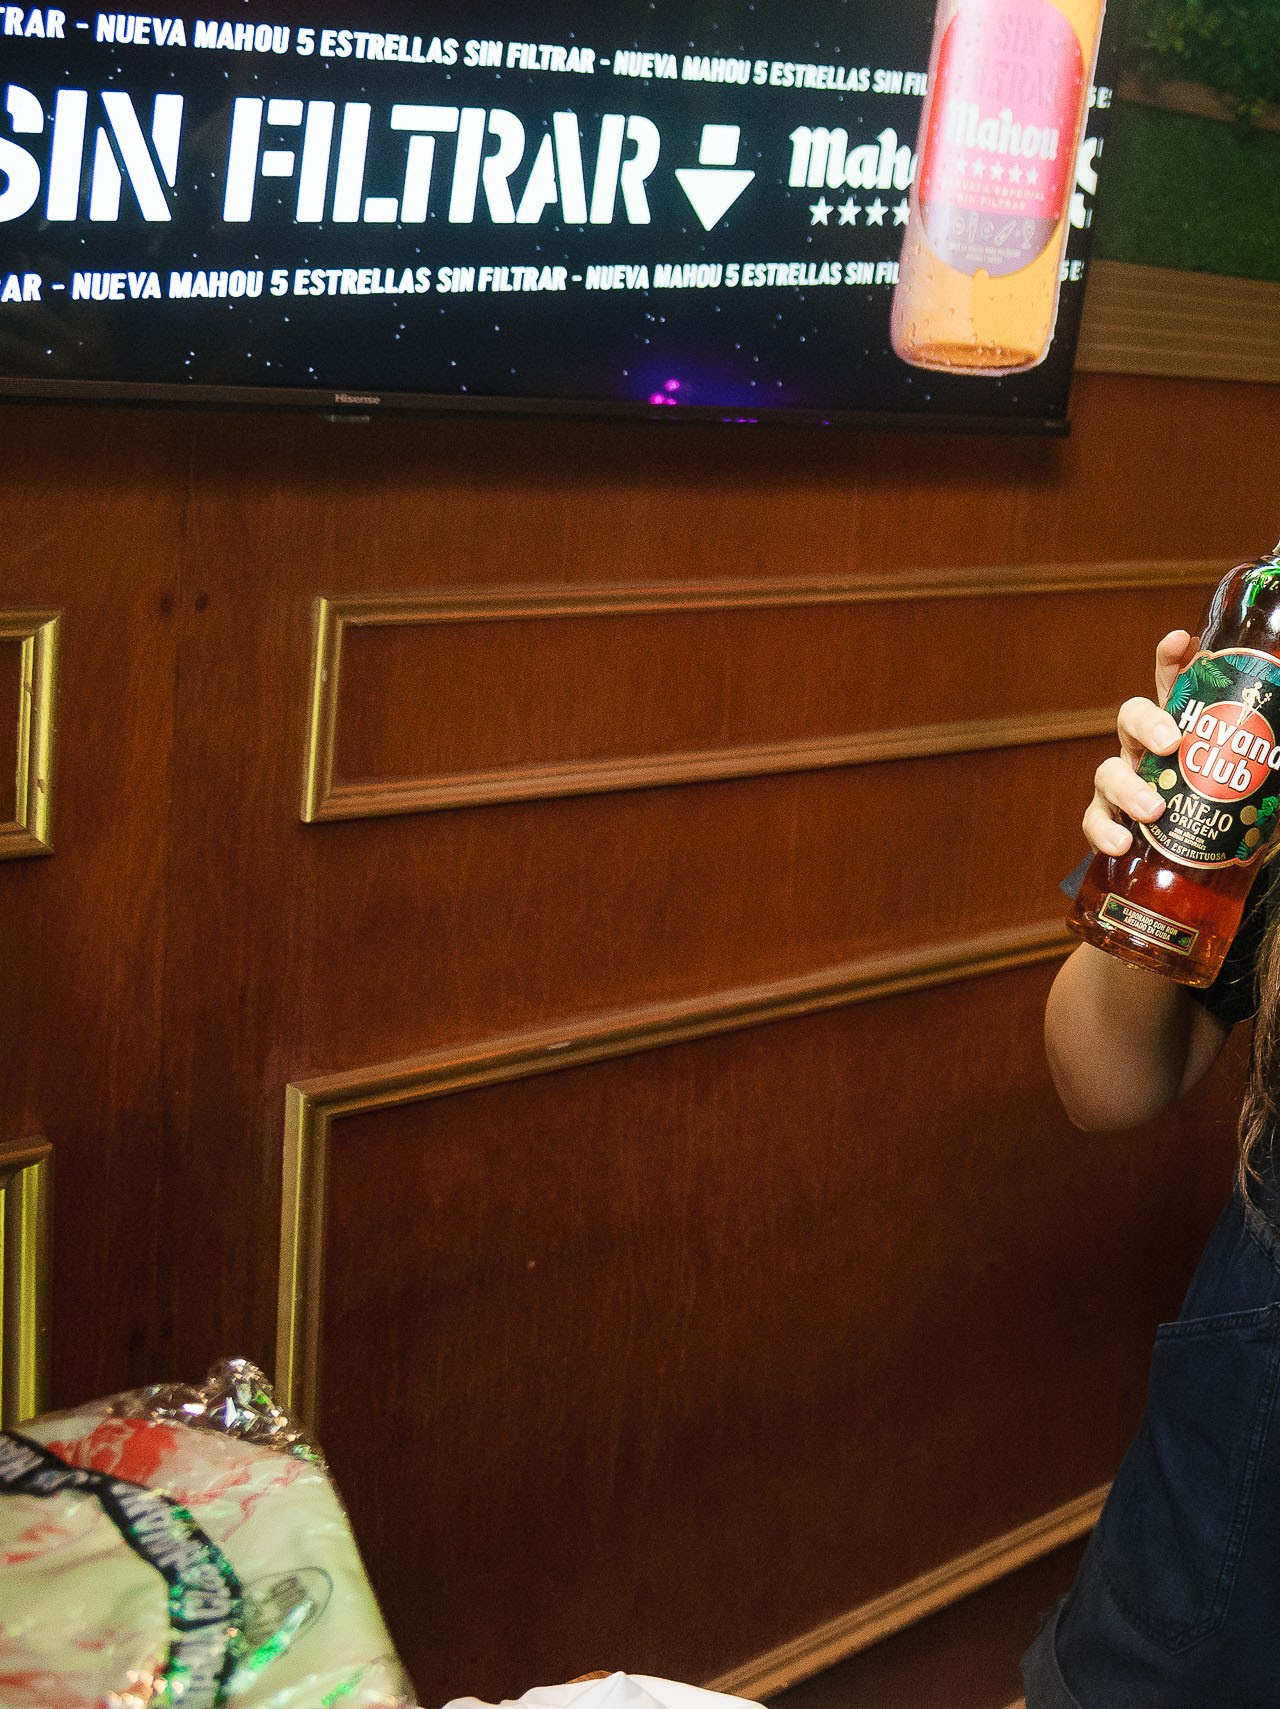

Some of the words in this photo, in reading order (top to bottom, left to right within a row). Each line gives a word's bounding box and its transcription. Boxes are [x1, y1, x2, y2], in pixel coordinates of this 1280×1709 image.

[0, 7, 65, 38] RAR
[97, 14, 186, 46] NUEVA
[194, 21, 290, 53] MAHOU
[297, 28, 315, 55] 5
[320, 30, 459, 65] ESTRELLAS
[464, 40, 503, 67] SIN
[507, 43, 595, 73] FILTRAR
[614, 50, 677, 79] NUEVA
[682, 56, 751, 84] MAHOU
[753, 60, 768, 84] 5
[769, 61, 870, 92] ESTRELLAS
[872, 68, 903, 94] SIN
[945, 101, 1060, 161] Mahou
[0, 84, 184, 222] SIN
[224, 98, 661, 225] FILTRAR
[788, 126, 919, 190] Mah
[0, 274, 41, 302] AR
[72, 272, 161, 300] NUEVA
[169, 270, 263, 298] MAHOU
[270, 270, 288, 296] 5
[294, 266, 431, 295] ESTRELLAS
[436, 266, 475, 293] SIN
[478, 265, 567, 291] FILTRAR
[585, 265, 649, 290] NUEVA
[653, 264, 722, 288] MAHOU
[725, 263, 740, 287] 5
[742, 262, 842, 287] ESTRELLAS
[844, 261, 875, 285] SIN
[335, 393, 381, 404] Hisense
[1185, 742, 1252, 792] Club
[1167, 793, 1233, 832] AÑEJO
[1169, 812, 1218, 840] ORIGEN
[1171, 842, 1227, 861] ESPIRITUOSA
[1122, 907, 1154, 926] ELABORADO
[1153, 921, 1166, 931] CON
[1165, 926, 1178, 936] RON
[1147, 925, 1156, 934] EN
[1155, 929, 1171, 941] CUBA
